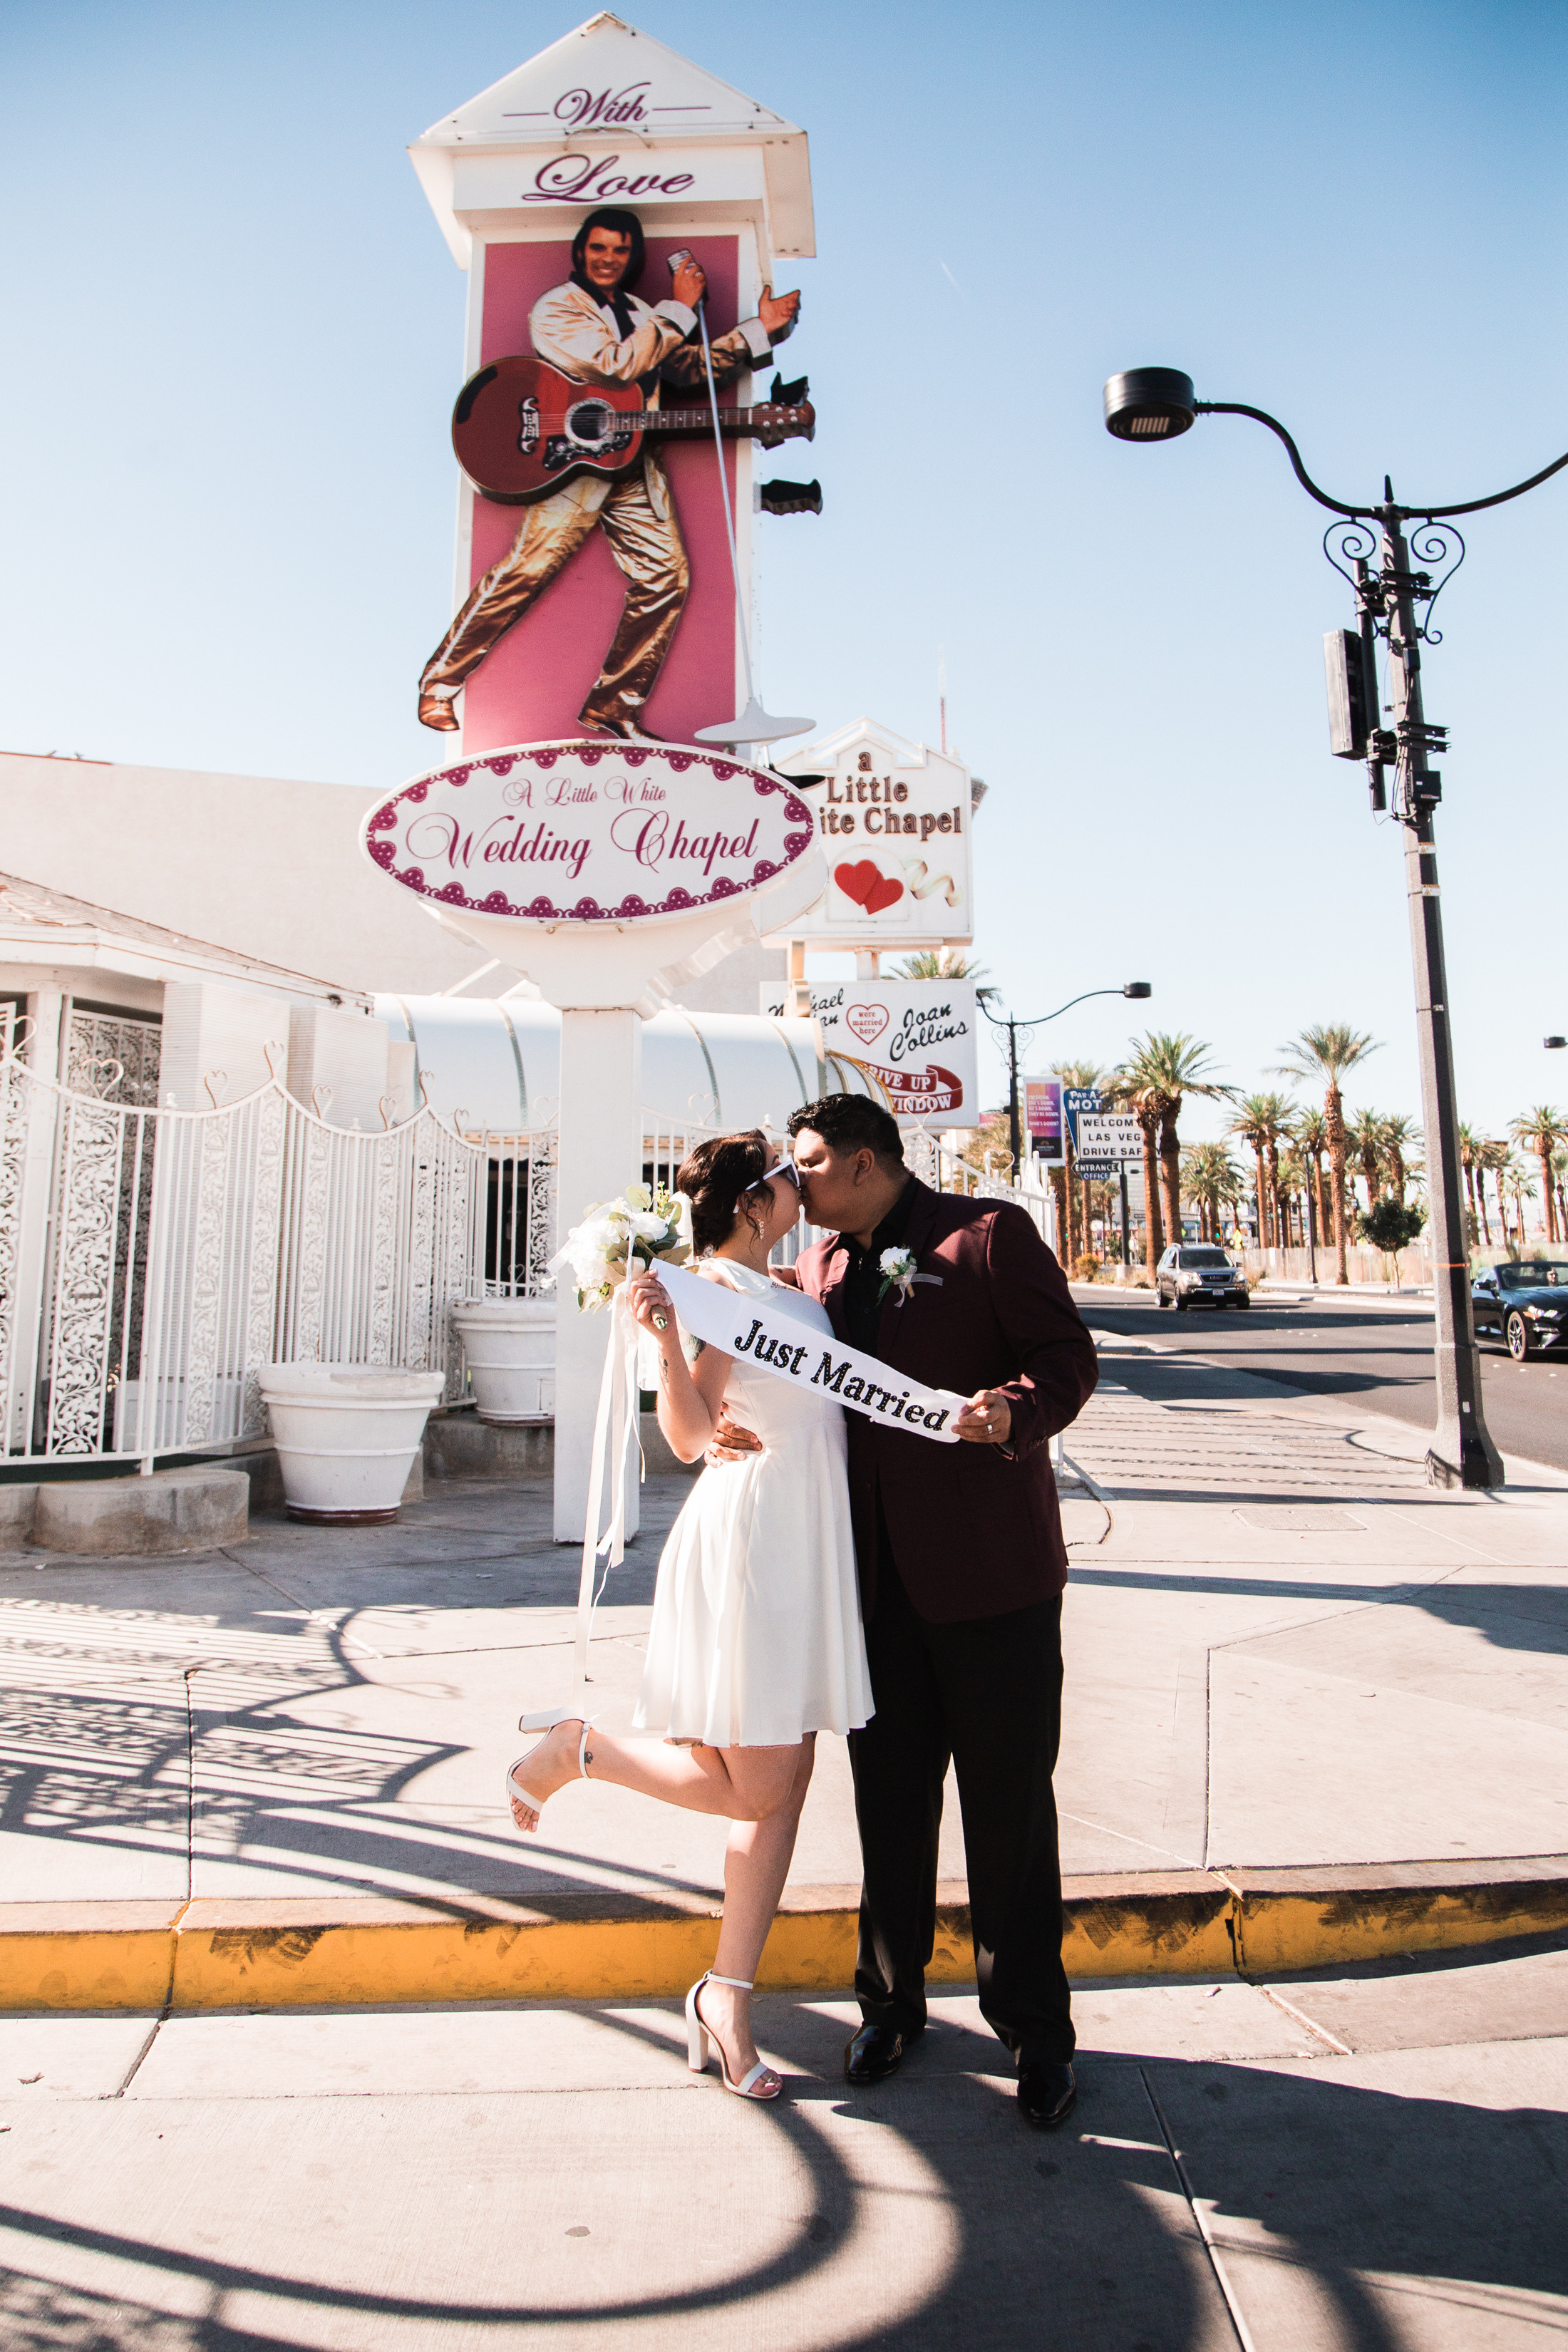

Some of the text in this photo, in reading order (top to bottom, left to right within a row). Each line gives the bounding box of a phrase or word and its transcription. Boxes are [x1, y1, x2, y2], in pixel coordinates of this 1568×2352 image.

[553, 82, 651, 125] With
[522, 153, 696, 202] Love
[857, 751, 872, 771] a
[502, 775, 666, 808] A Little White
[827, 775, 909, 803] Little
[819, 805, 962, 842] ite Chapel
[405, 808, 760, 879] Wedding Chapel
[903, 1004, 952, 1039] Joan
[889, 1021, 969, 1062] Collins
[911, 1076, 931, 1090] UP
[1075, 1163, 1117, 1172] ENTRANCE
[734, 1319, 951, 1432] Just Married
